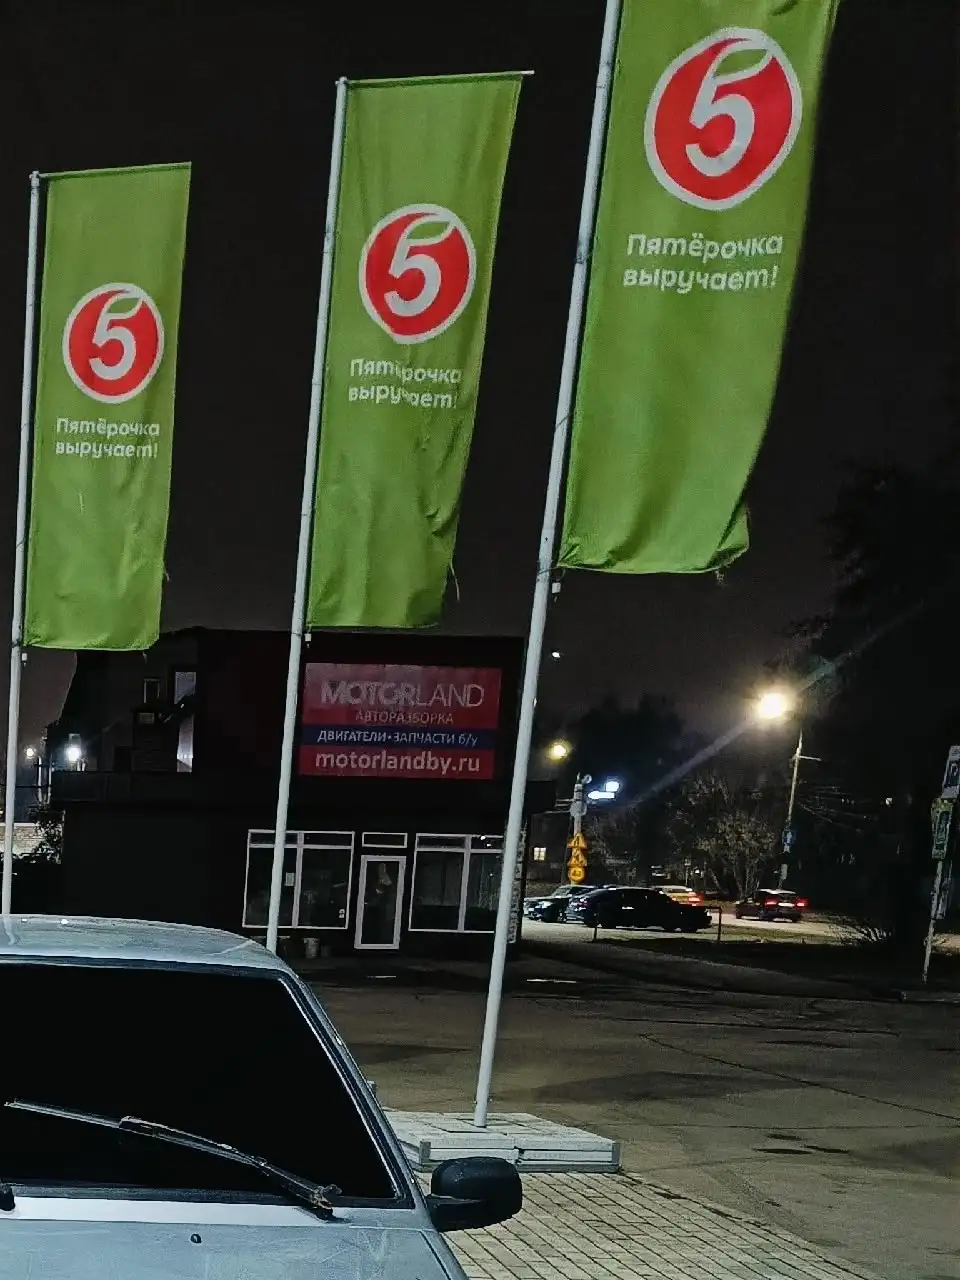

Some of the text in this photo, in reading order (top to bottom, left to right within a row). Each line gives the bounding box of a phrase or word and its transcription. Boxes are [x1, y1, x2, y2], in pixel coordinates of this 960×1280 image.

[627, 232, 783, 264] Пятёрочка
[623, 265, 779, 294] выручает!
[56, 417, 160, 439] Пятёрочка
[55, 441, 158, 458] выручает!
[320, 680, 485, 708] MOTORLAND
[355, 709, 454, 724] АВТОРАЗБОРКА
[315, 749, 481, 775] motorlandby.ru
